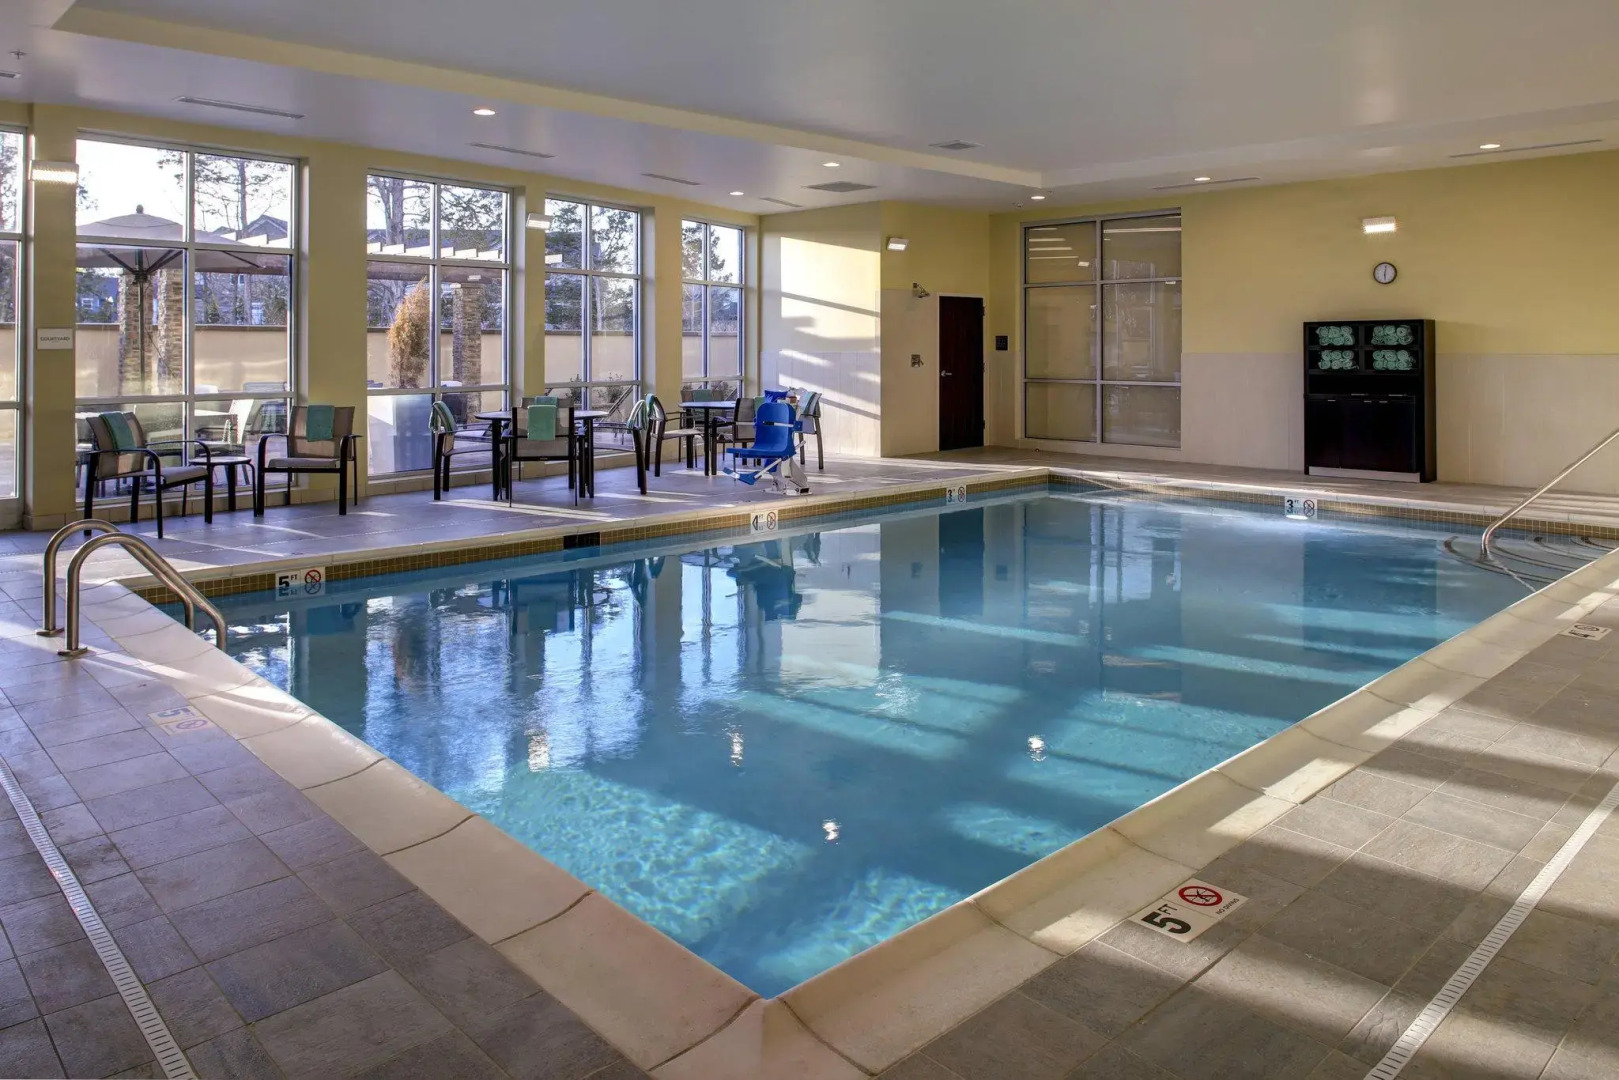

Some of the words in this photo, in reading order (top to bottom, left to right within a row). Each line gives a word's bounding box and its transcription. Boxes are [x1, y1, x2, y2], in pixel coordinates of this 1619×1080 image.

[278, 575, 290, 588] 5
[1157, 903, 1178, 916] FT
[1223, 897, 1240, 911] DIVING
[1141, 911, 1192, 934] 5
